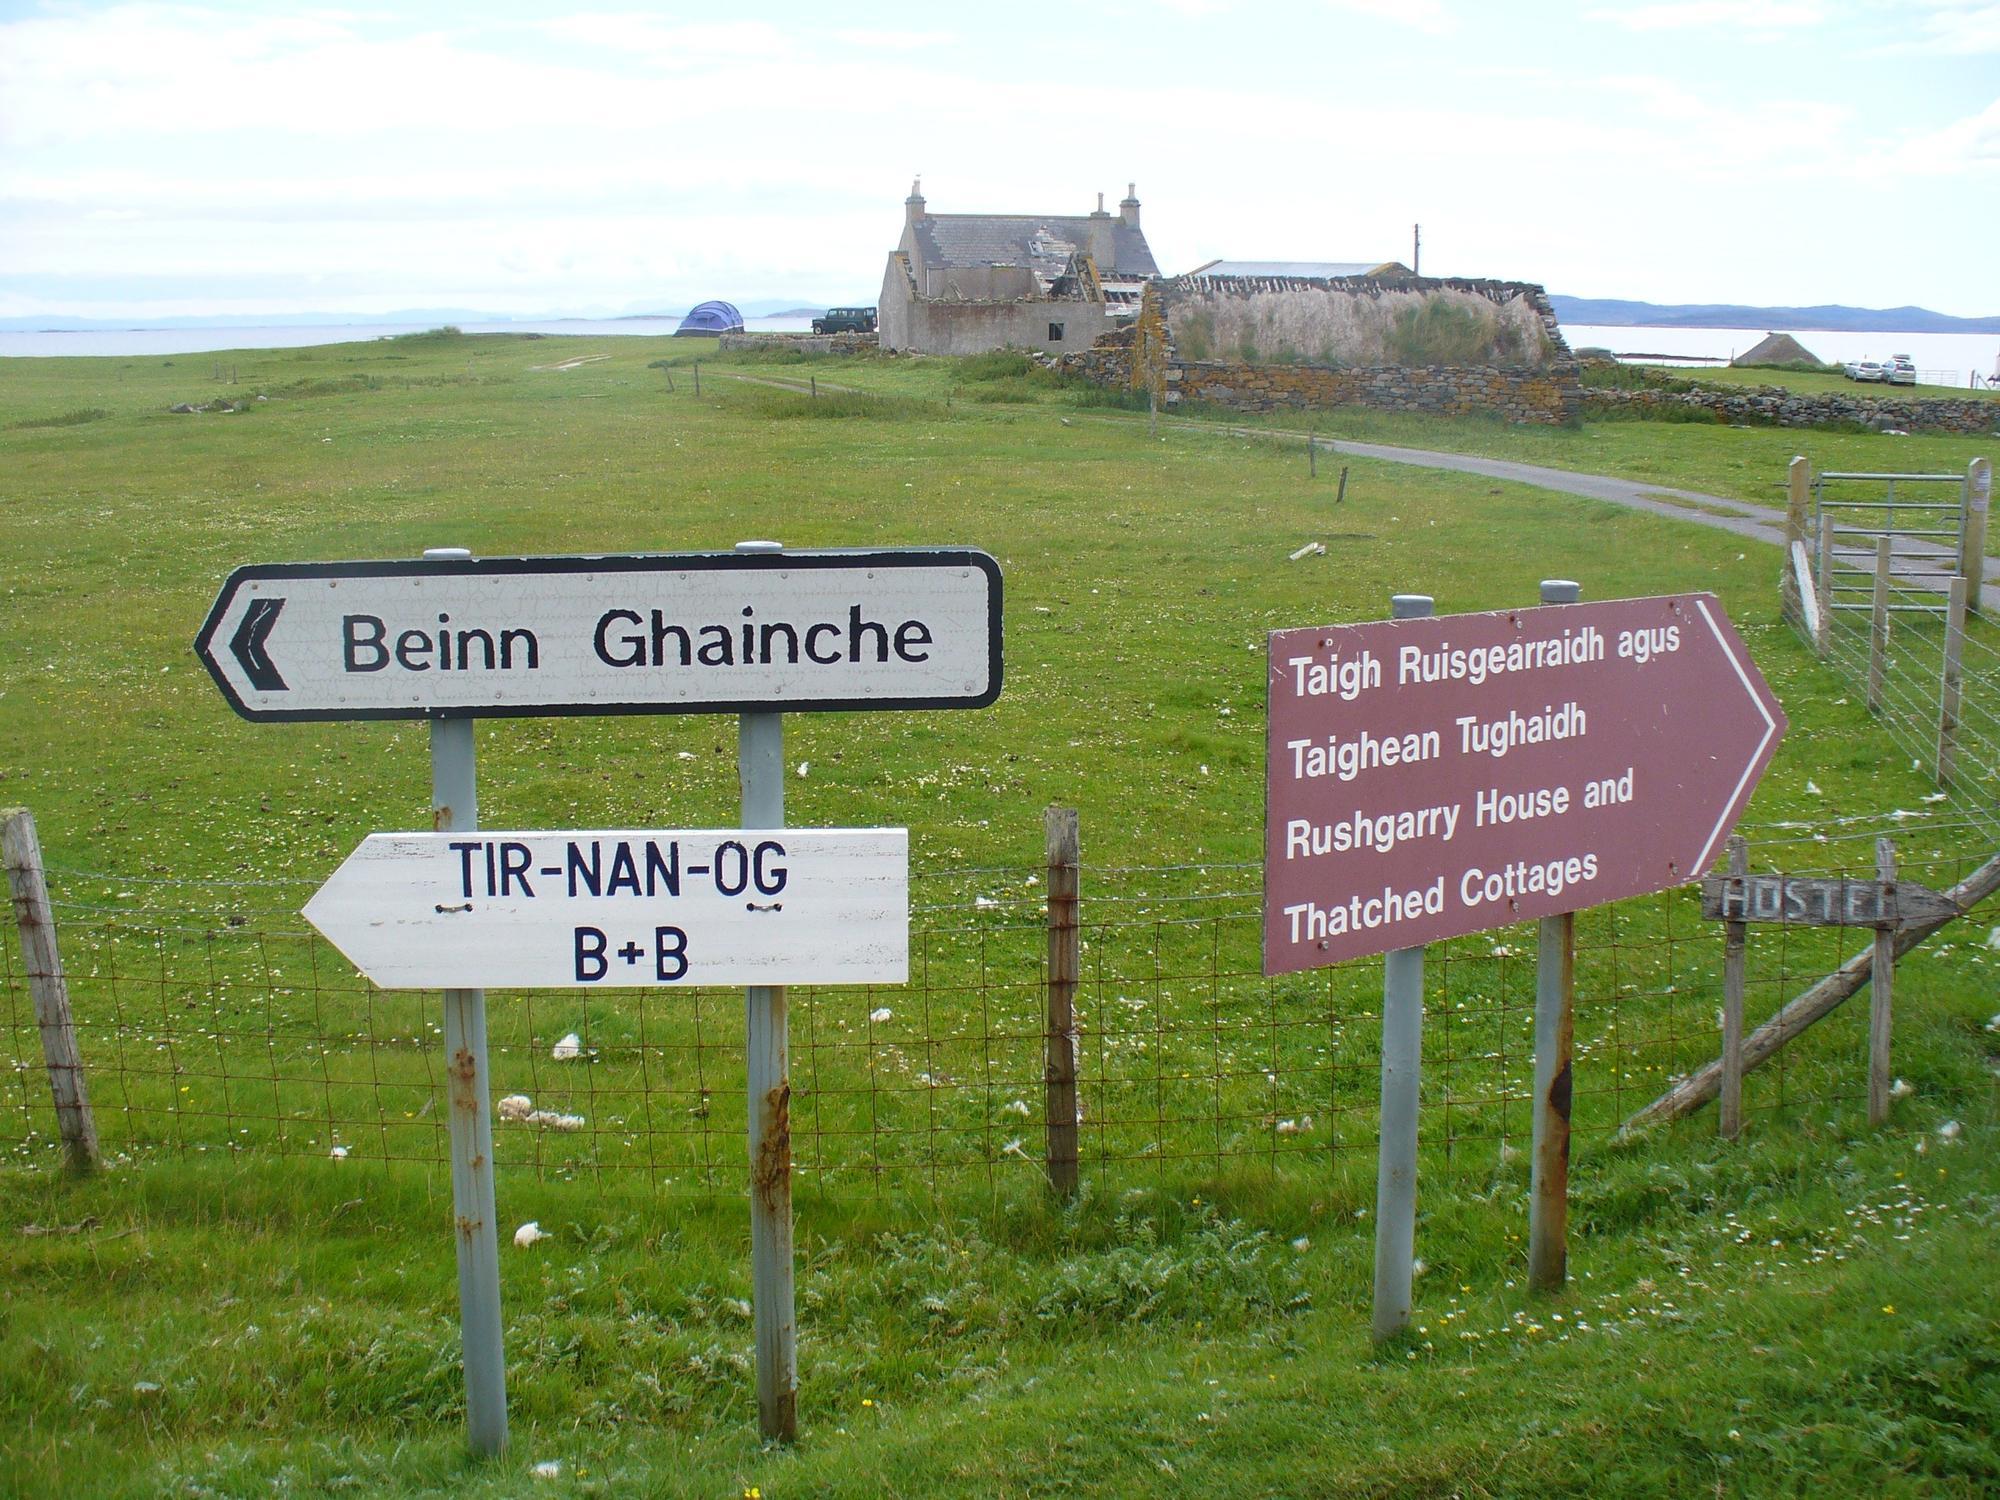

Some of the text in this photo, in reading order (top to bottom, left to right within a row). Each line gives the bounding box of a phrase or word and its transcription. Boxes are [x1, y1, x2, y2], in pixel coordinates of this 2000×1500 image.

[342, 604, 933, 672] Beinn Ghainche
[1289, 626, 1680, 700] Taigh Ruisgearraidh agus
[1288, 702, 1586, 781] Taighean Tughaidh
[1287, 768, 1633, 859] Rushgarry House and
[450, 841, 788, 897] TIR-NAN-OG
[1284, 854, 1598, 944] Thatched Cottages
[574, 926, 689, 982] B+B
